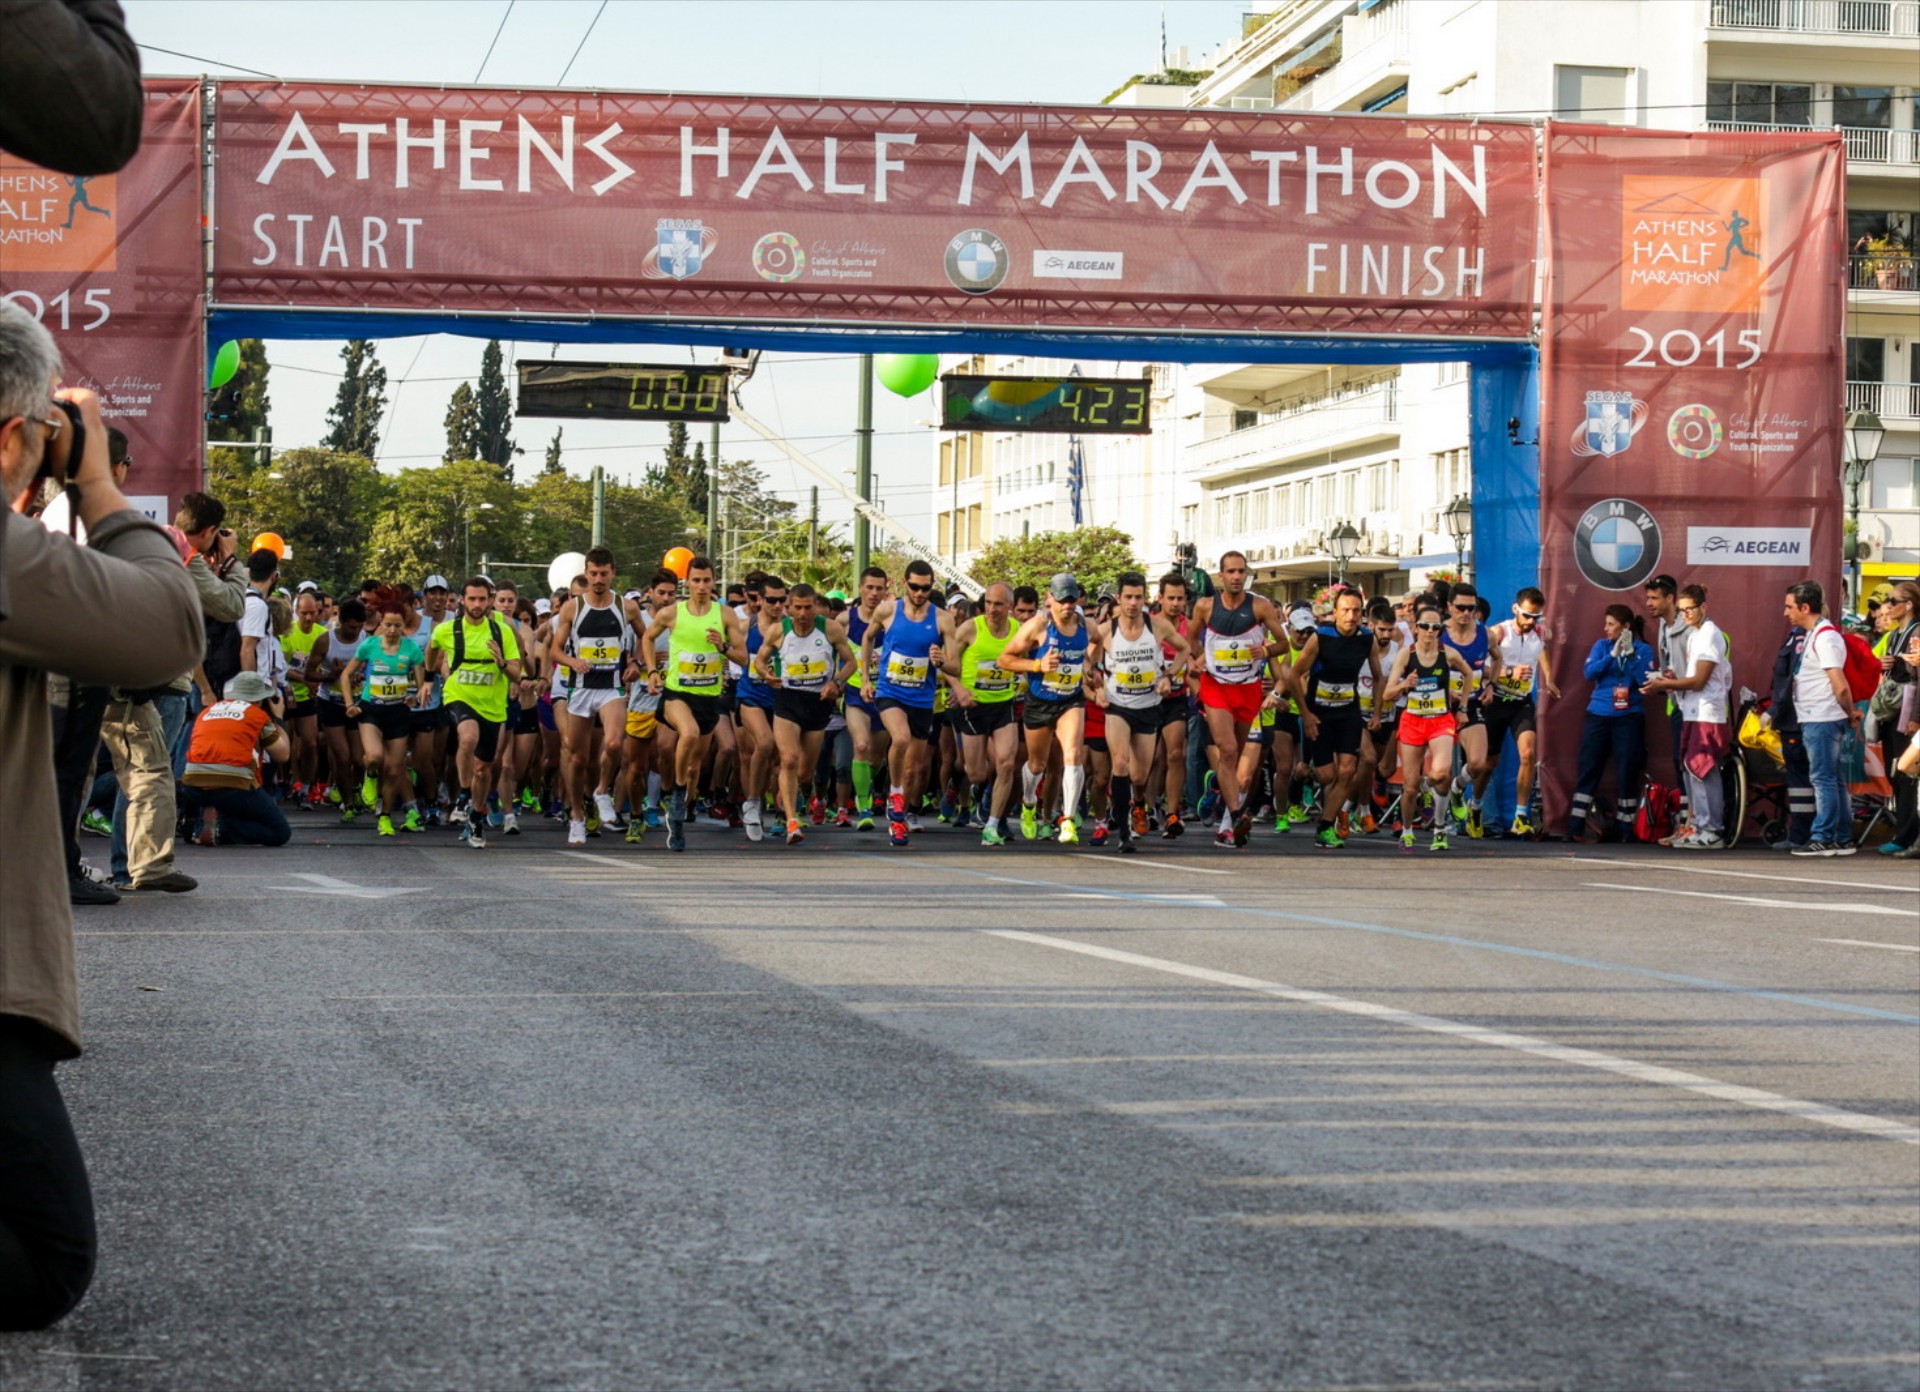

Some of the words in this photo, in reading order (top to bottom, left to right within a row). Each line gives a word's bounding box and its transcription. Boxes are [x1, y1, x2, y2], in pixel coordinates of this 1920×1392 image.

[256, 111, 636, 197] ATHENS
[680, 124, 918, 202] HALF
[957, 130, 1488, 219] MARATHON
[656, 218, 703, 230] SEGAS
[1632, 219, 1718, 237] ATHENS
[252, 213, 423, 270] START
[951, 231, 1003, 253] BMW
[811, 239, 832, 258] City
[850, 240, 887, 256] Athens
[1632, 240, 1718, 267] HALF
[841, 256, 863, 268] Sports
[864, 257, 878, 267] and
[1067, 260, 1116, 271] AEGEAN
[811, 267, 831, 277] Youth
[1306, 242, 1486, 298] FINISH
[1630, 269, 1720, 287] MARATHON
[1623, 326, 1763, 370] 2015
[111, 394, 136, 407] Sports
[136, 394, 152, 405] and
[1586, 391, 1633, 402] SEGAS
[1728, 412, 1751, 432] City
[1770, 412, 1809, 428] Athens
[1760, 430, 1784, 442] Sports
[1784, 431, 1799, 440] and
[1728, 442, 1749, 452] Youth
[1582, 502, 1654, 531] BMW
[1733, 541, 1801, 555] AEGEAN
[592, 647, 607, 659] 45
[1231, 650, 1238, 661] 4
[693, 662, 707, 674] 77
[802, 664, 810, 675] 3
[900, 665, 915, 676] 58
[459, 670, 493, 686] 2174
[989, 669, 1003, 680] 22
[1058, 673, 1072, 685] 73
[1127, 673, 1143, 684] 48
[382, 684, 397, 696] 121
[1415, 682, 1438, 692] WIND
[1507, 678, 1521, 690] 80
[1418, 700, 1434, 710] 101
[205, 711, 242, 719] PHOTO
